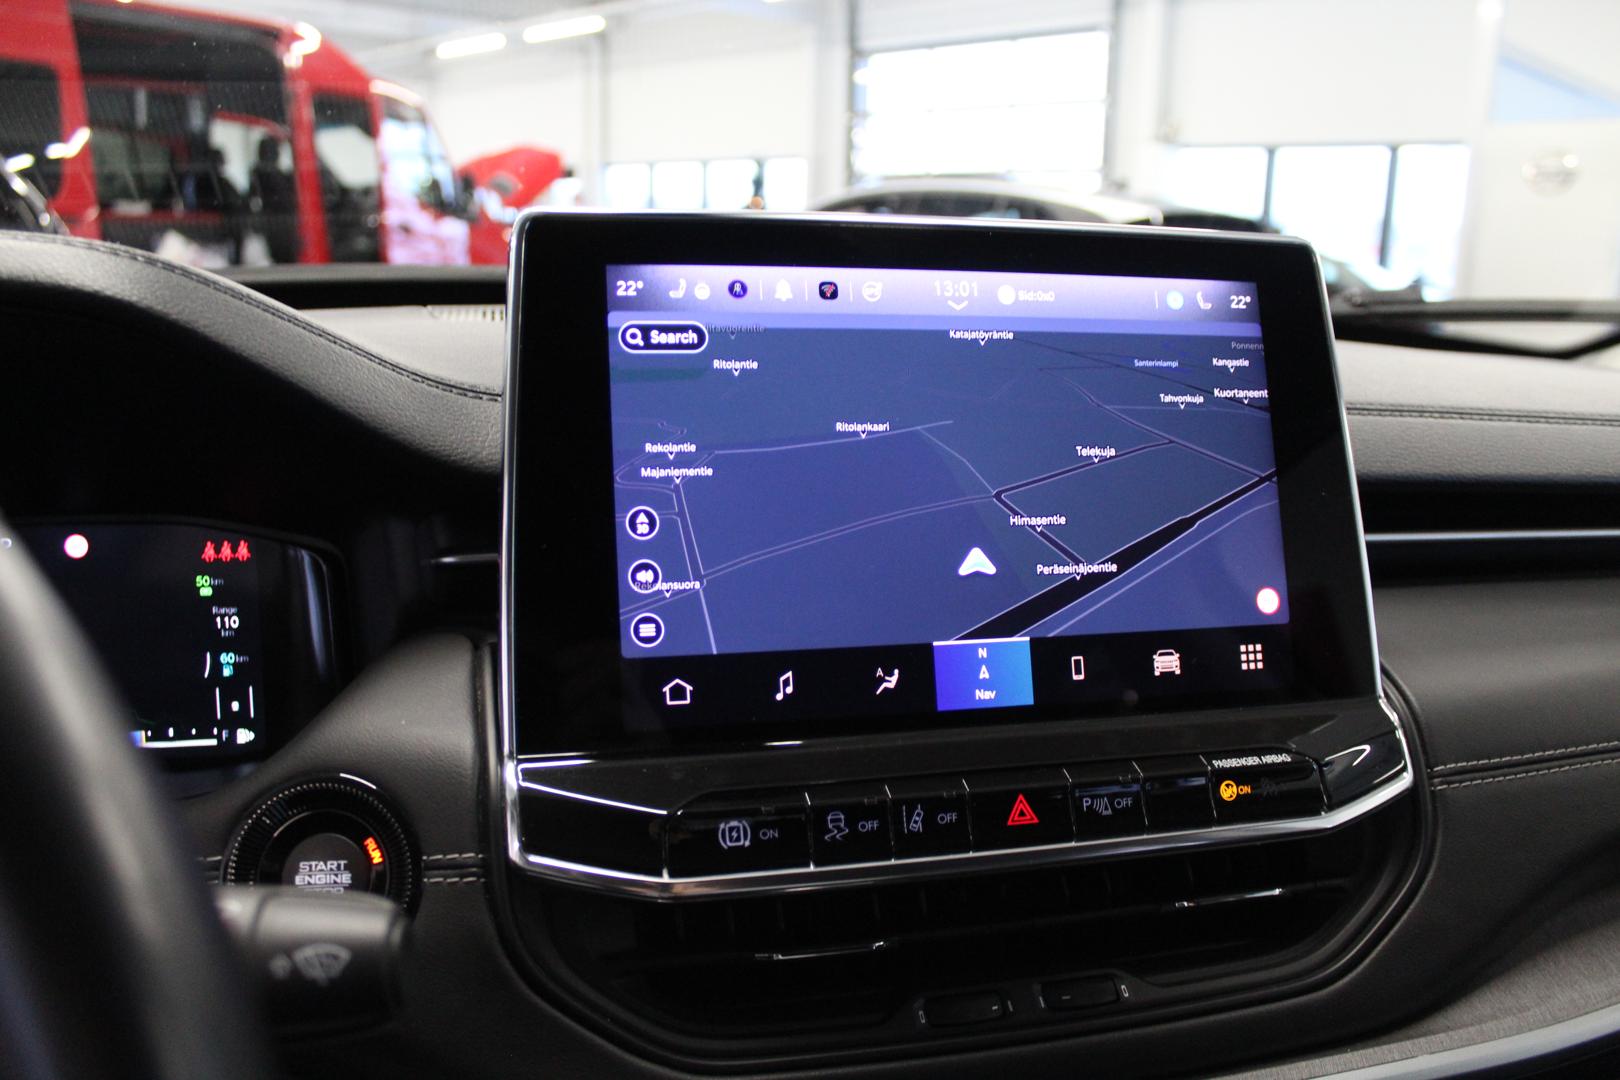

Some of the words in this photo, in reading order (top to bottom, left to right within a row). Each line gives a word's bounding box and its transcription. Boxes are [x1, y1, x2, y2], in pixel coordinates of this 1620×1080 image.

[616, 280, 644, 297] 22°
[934, 279, 978, 297] 13:01
[1230, 295, 1252, 309] 22°
[650, 329, 698, 344] Search
[713, 358, 759, 370] Ritolantie
[1212, 357, 1250, 369] Kangastie
[1159, 393, 1204, 405] Tahvonkuja
[1213, 387, 1269, 399] Kuortaneent
[836, 421, 890, 434] Ritolankaari
[645, 442, 697, 454] Rekolantie
[1075, 445, 1116, 459] Telekuja
[640, 465, 714, 479] Majaniementie
[1009, 513, 1067, 526] Himasentie
[1036, 560, 1118, 576] Peräseinäjoentie
[195, 574, 211, 588] 50
[212, 605, 238, 615] Range
[215, 615, 240, 630] 110
[220, 652, 236, 665] 60
[978, 647, 988, 659] N
[975, 688, 997, 701] Nav
[1212, 756, 1262, 769] PASSENGER
[1261, 753, 1292, 765] AIRBAG
[1238, 785, 1251, 795] ON
[1114, 797, 1133, 809] OFF
[937, 812, 959, 824] OFF
[858, 821, 880, 833] OFF
[759, 828, 779, 841] ON
[364, 836, 384, 865] RUN
[299, 860, 349, 873] START
[295, 873, 353, 886] ENGINE
